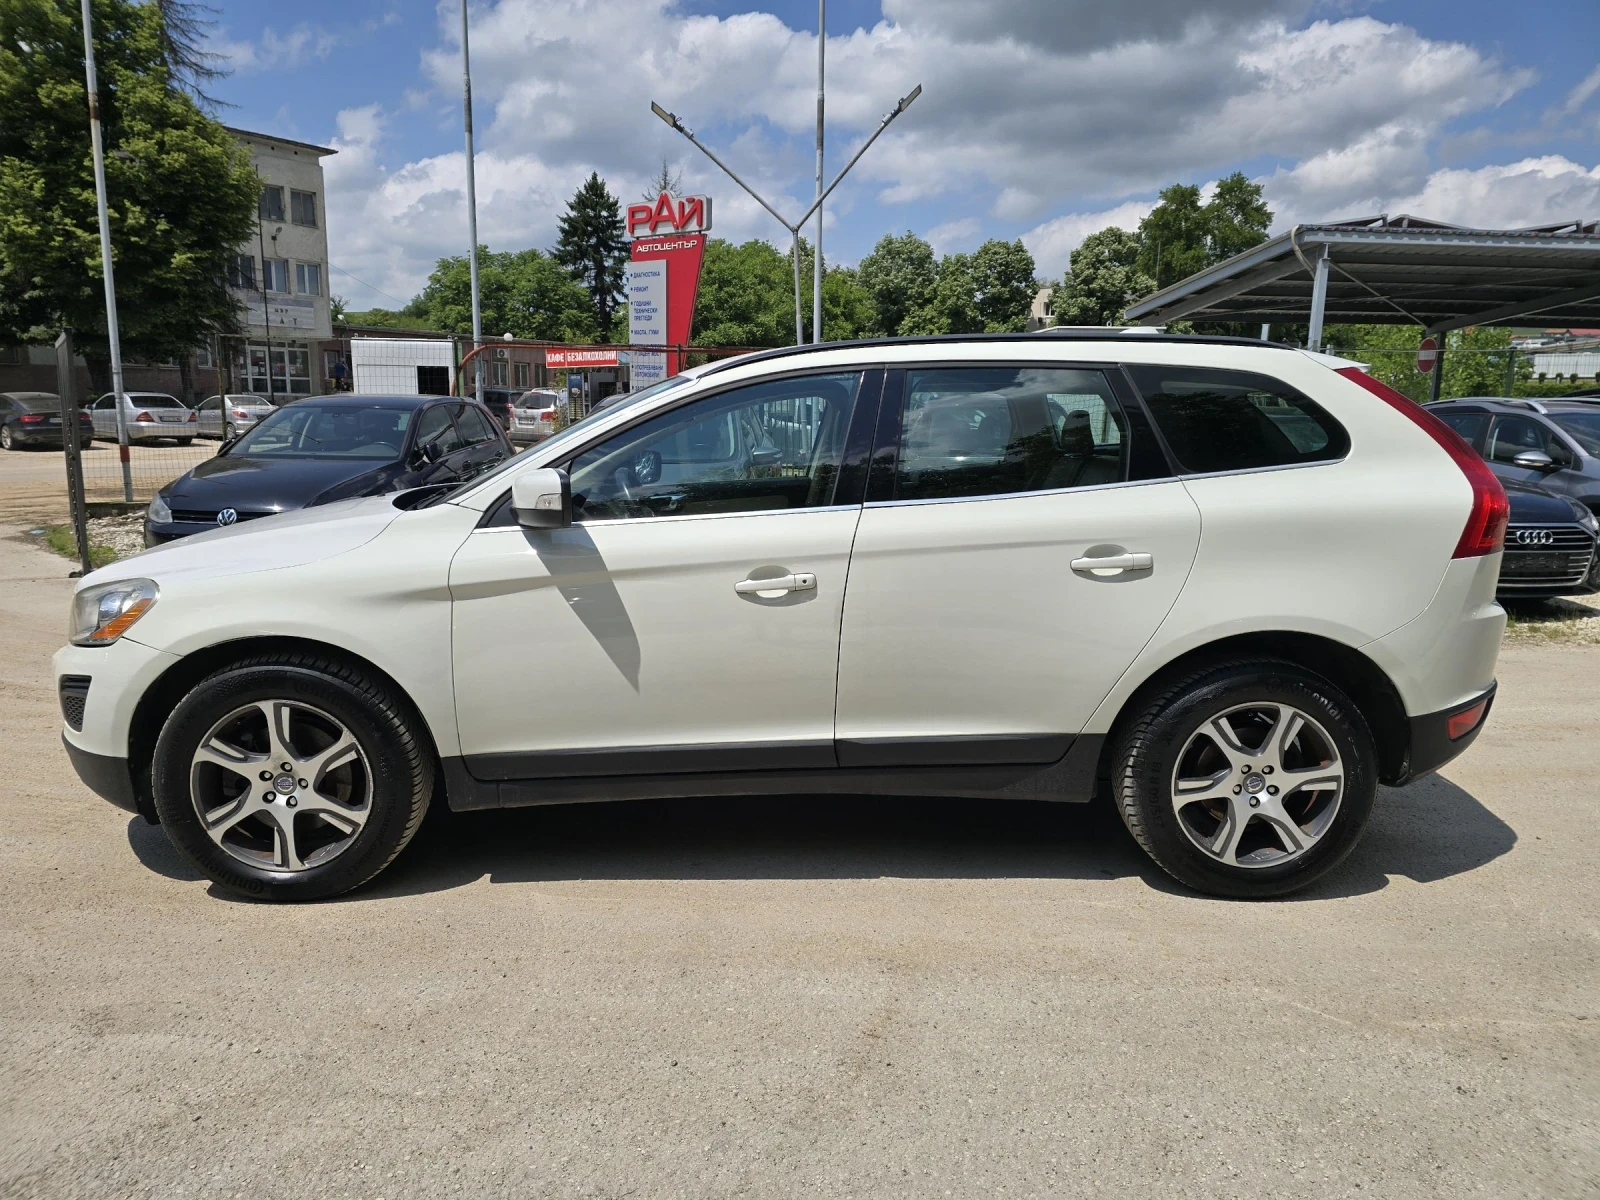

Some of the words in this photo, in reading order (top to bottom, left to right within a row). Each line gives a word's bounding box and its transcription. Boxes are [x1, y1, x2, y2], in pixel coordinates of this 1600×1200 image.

[627, 192, 703, 235] РАЙ
[546, 352, 565, 363] КАФЕ
[567, 350, 617, 362] БЕЗАЛКОХОЛНИ
